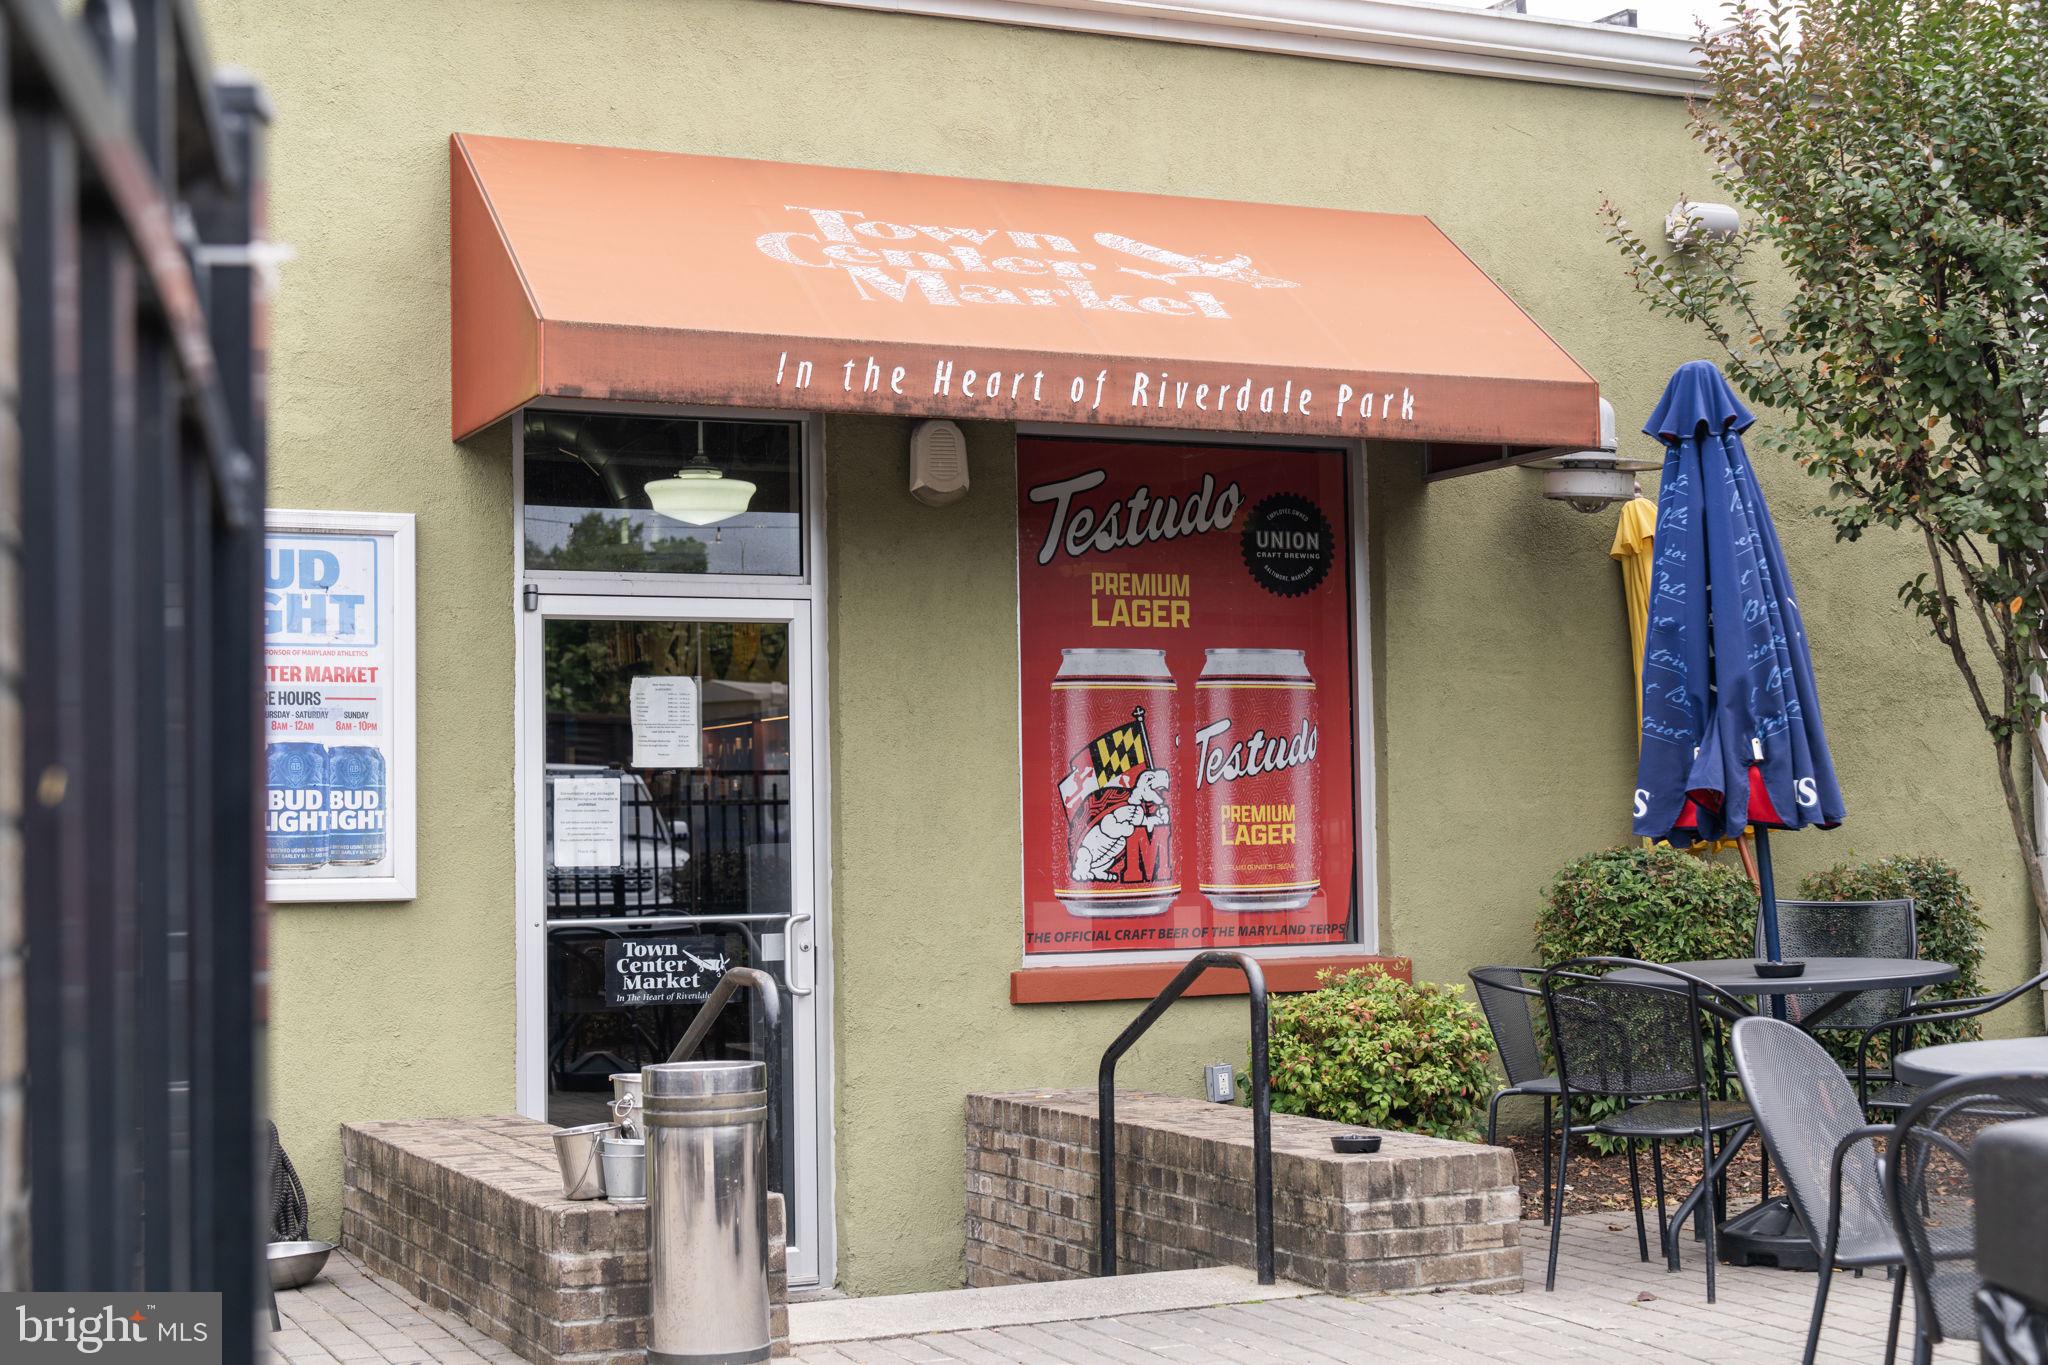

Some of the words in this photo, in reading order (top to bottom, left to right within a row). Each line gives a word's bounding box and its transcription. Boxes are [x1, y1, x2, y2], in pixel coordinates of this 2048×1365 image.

[784, 204, 1080, 254] Town
[755, 230, 1097, 277] Center
[843, 263, 1232, 320] Market
[776, 351, 813, 389] In
[843, 355, 906, 395] the
[935, 359, 1046, 403] Heart
[1070, 368, 1107, 410] of
[1131, 370, 1313, 417] Riverdale
[1337, 382, 1417, 421] Park
[1029, 469, 1245, 565] Testudo
[1256, 531, 1320, 550] UNION
[1256, 551, 1281, 559] CRAFT
[1284, 552, 1321, 560] BREWING
[264, 549, 340, 590] UD
[1091, 572, 1190, 598] PREMIUM
[1091, 598, 1190, 628] LAGER
[301, 649, 336, 657] MARYLAND
[305, 666, 379, 683] MARKET
[278, 691, 322, 706] HOURS
[264, 711, 290, 719] URSDAY
[295, 711, 329, 719] SATURDAY
[344, 711, 369, 719] SUNDAY
[271, 721, 288, 731] 8AM
[295, 721, 314, 731] 12AM
[336, 721, 352, 731] 8AM
[359, 721, 378, 731] 10PM
[1196, 718, 1317, 790] Testudo
[268, 789, 323, 810] BUD
[330, 790, 379, 810] BUD
[331, 810, 385, 830] IGHT
[1221, 803, 1296, 823] PREMIUM
[1221, 824, 1296, 846] LAGER
[1027, 931, 1051, 944] THE
[1054, 929, 1112, 943] OFFICIAL
[1114, 928, 1156, 941] CRAFT
[1158, 927, 1189, 940] BEER
[1191, 926, 1210, 938] OF
[1212, 925, 1235, 938] THE
[1238, 924, 1306, 937] MARYLAND
[1309, 923, 1346, 935] TERPS
[622, 942, 678, 957] Town
[616, 957, 688, 974] Center
[622, 972, 701, 990] Market
[616, 993, 625, 1002] In
[626, 993, 641, 1002] The
[643, 992, 665, 1001] Heart
[666, 992, 676, 1002] of
